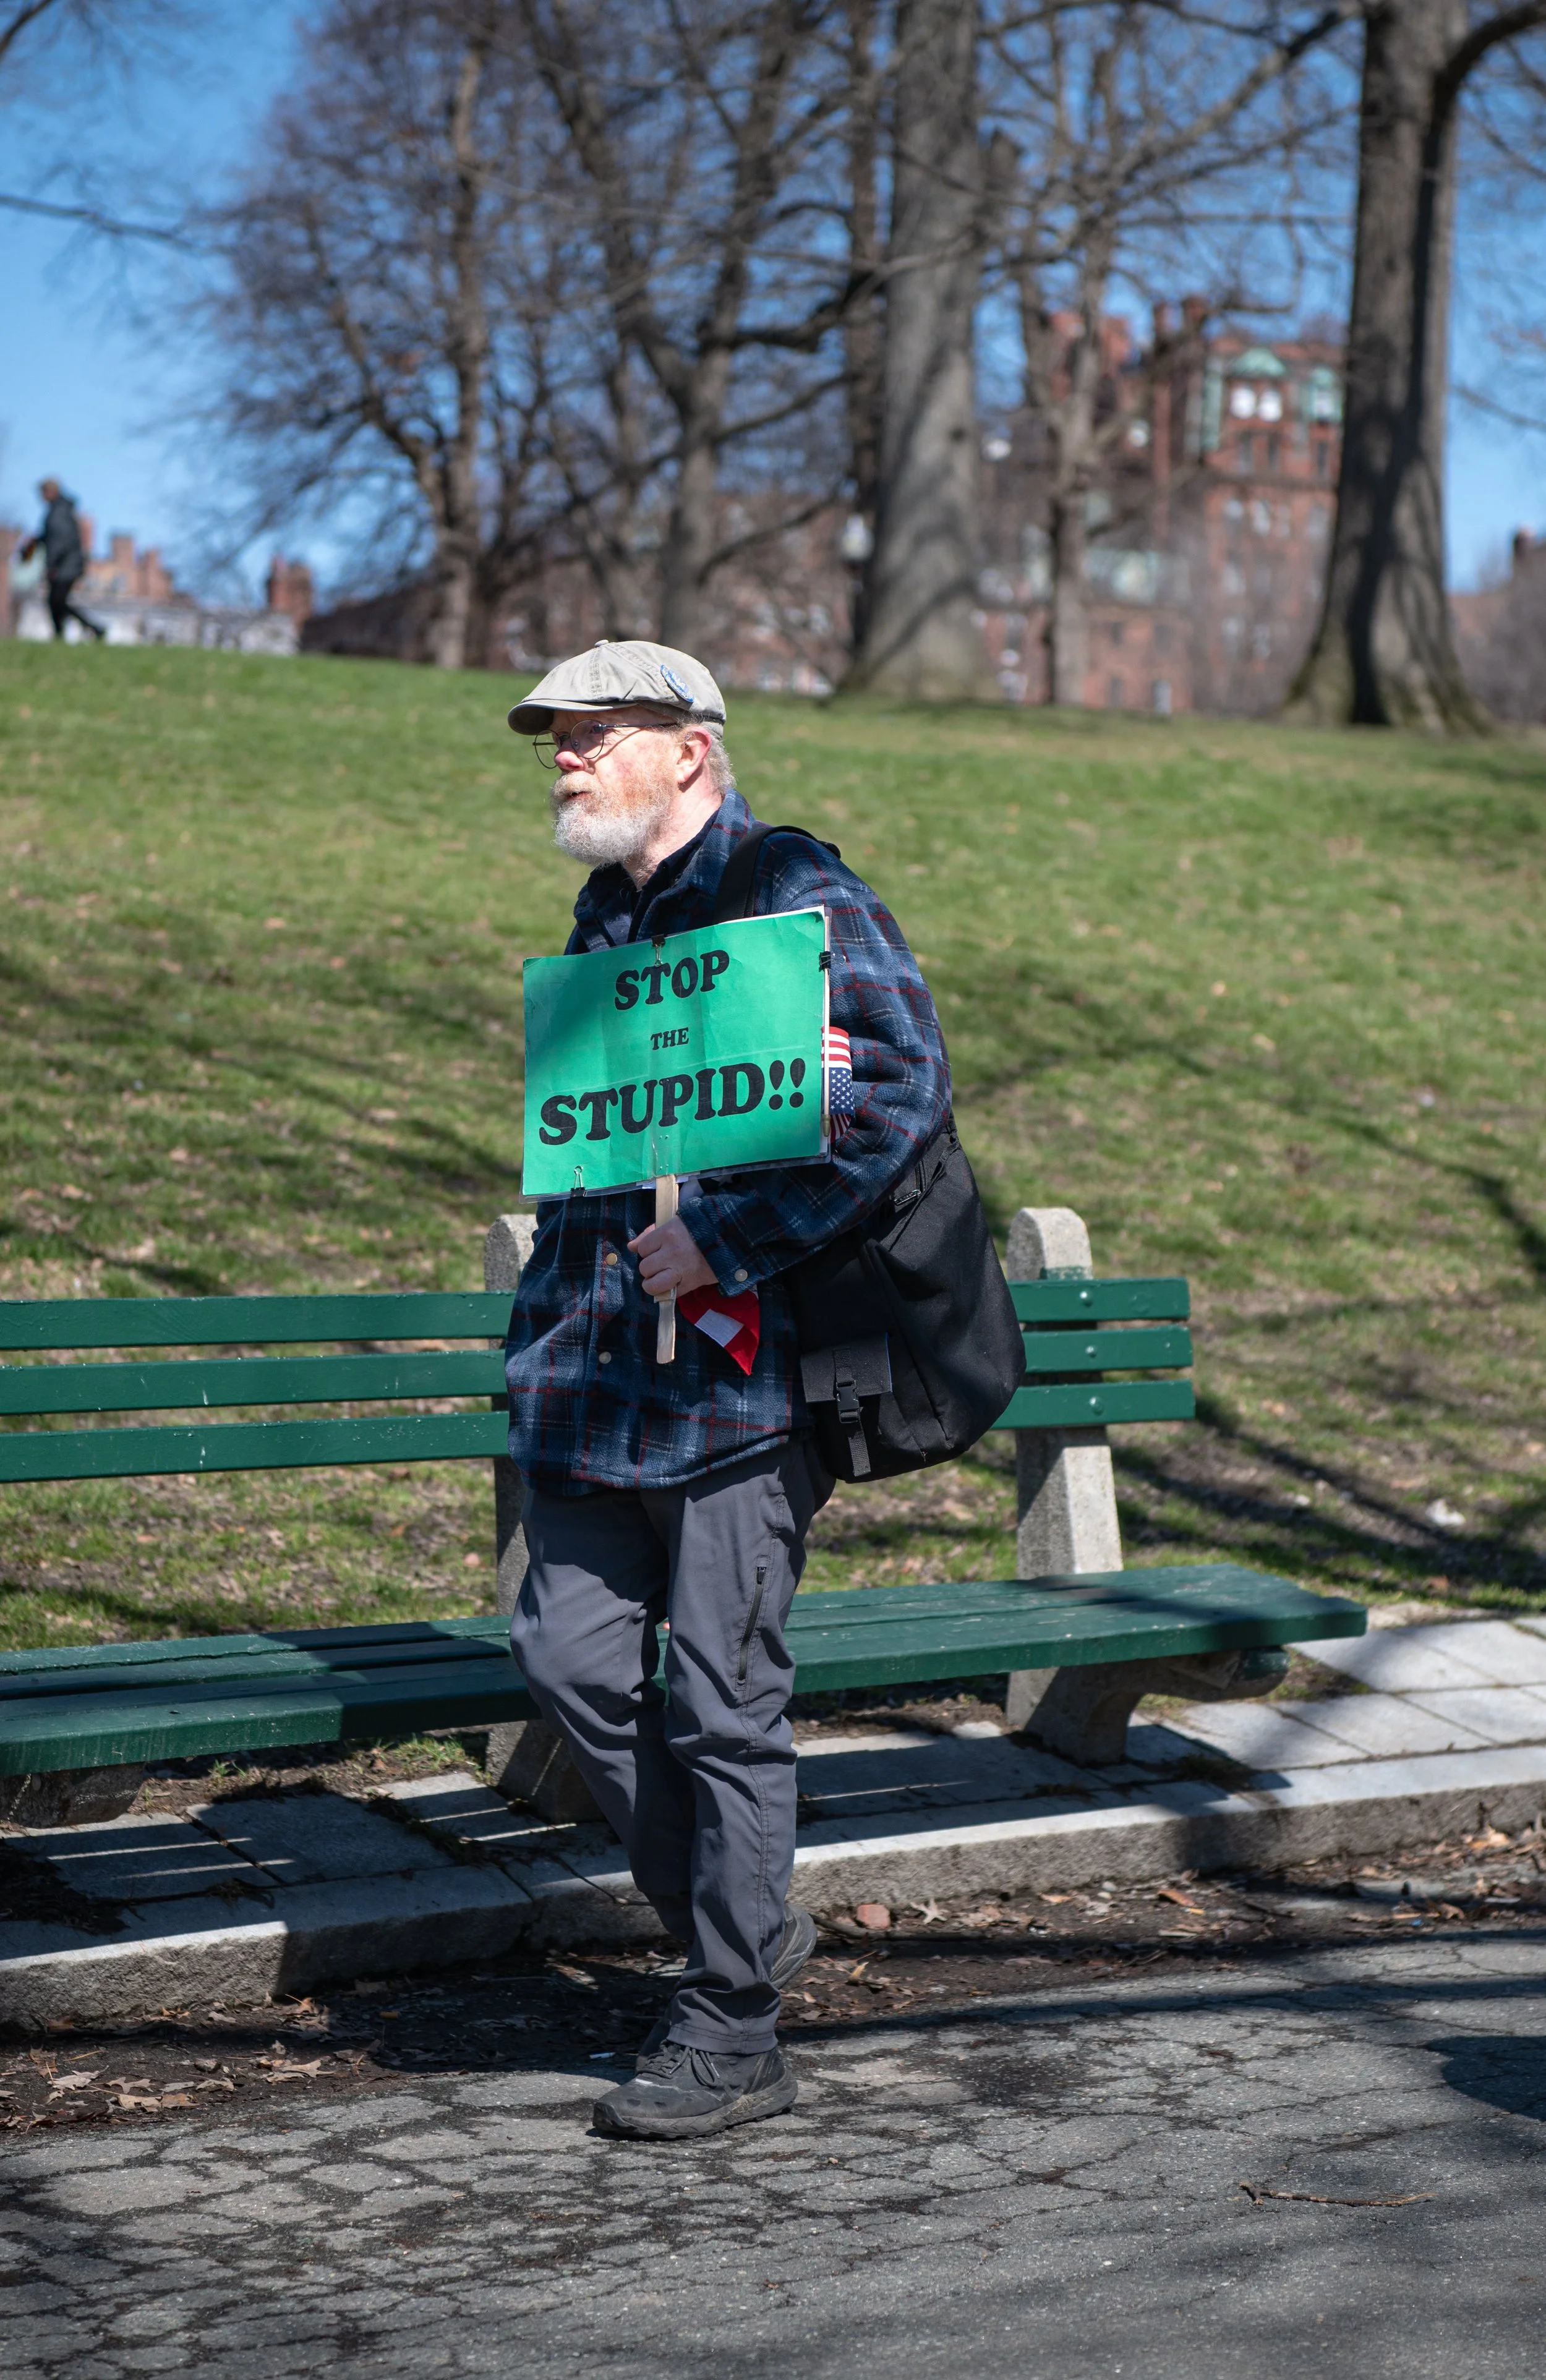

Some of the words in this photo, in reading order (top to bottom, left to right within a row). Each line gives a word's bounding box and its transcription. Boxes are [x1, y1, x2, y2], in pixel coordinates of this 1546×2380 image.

[615, 949, 729, 1010] STOP
[651, 1027, 689, 1051] THE
[539, 1058, 805, 1145] STUPID!!
